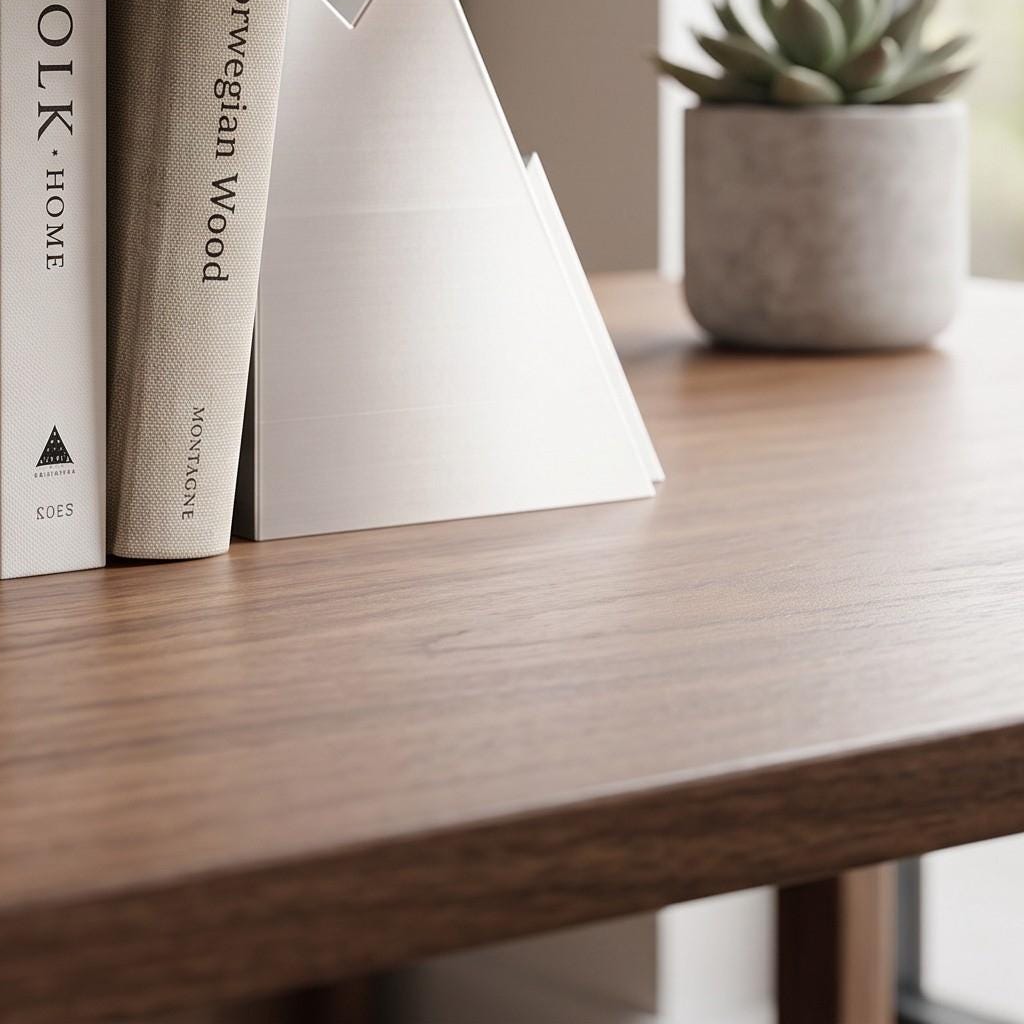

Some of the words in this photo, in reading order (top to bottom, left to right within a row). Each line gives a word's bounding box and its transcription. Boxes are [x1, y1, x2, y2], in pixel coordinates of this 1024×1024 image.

[46, 168, 65, 270] HOME
[202, 172, 239, 283] Wood
[182, 407, 205, 520] MONTAGNE
